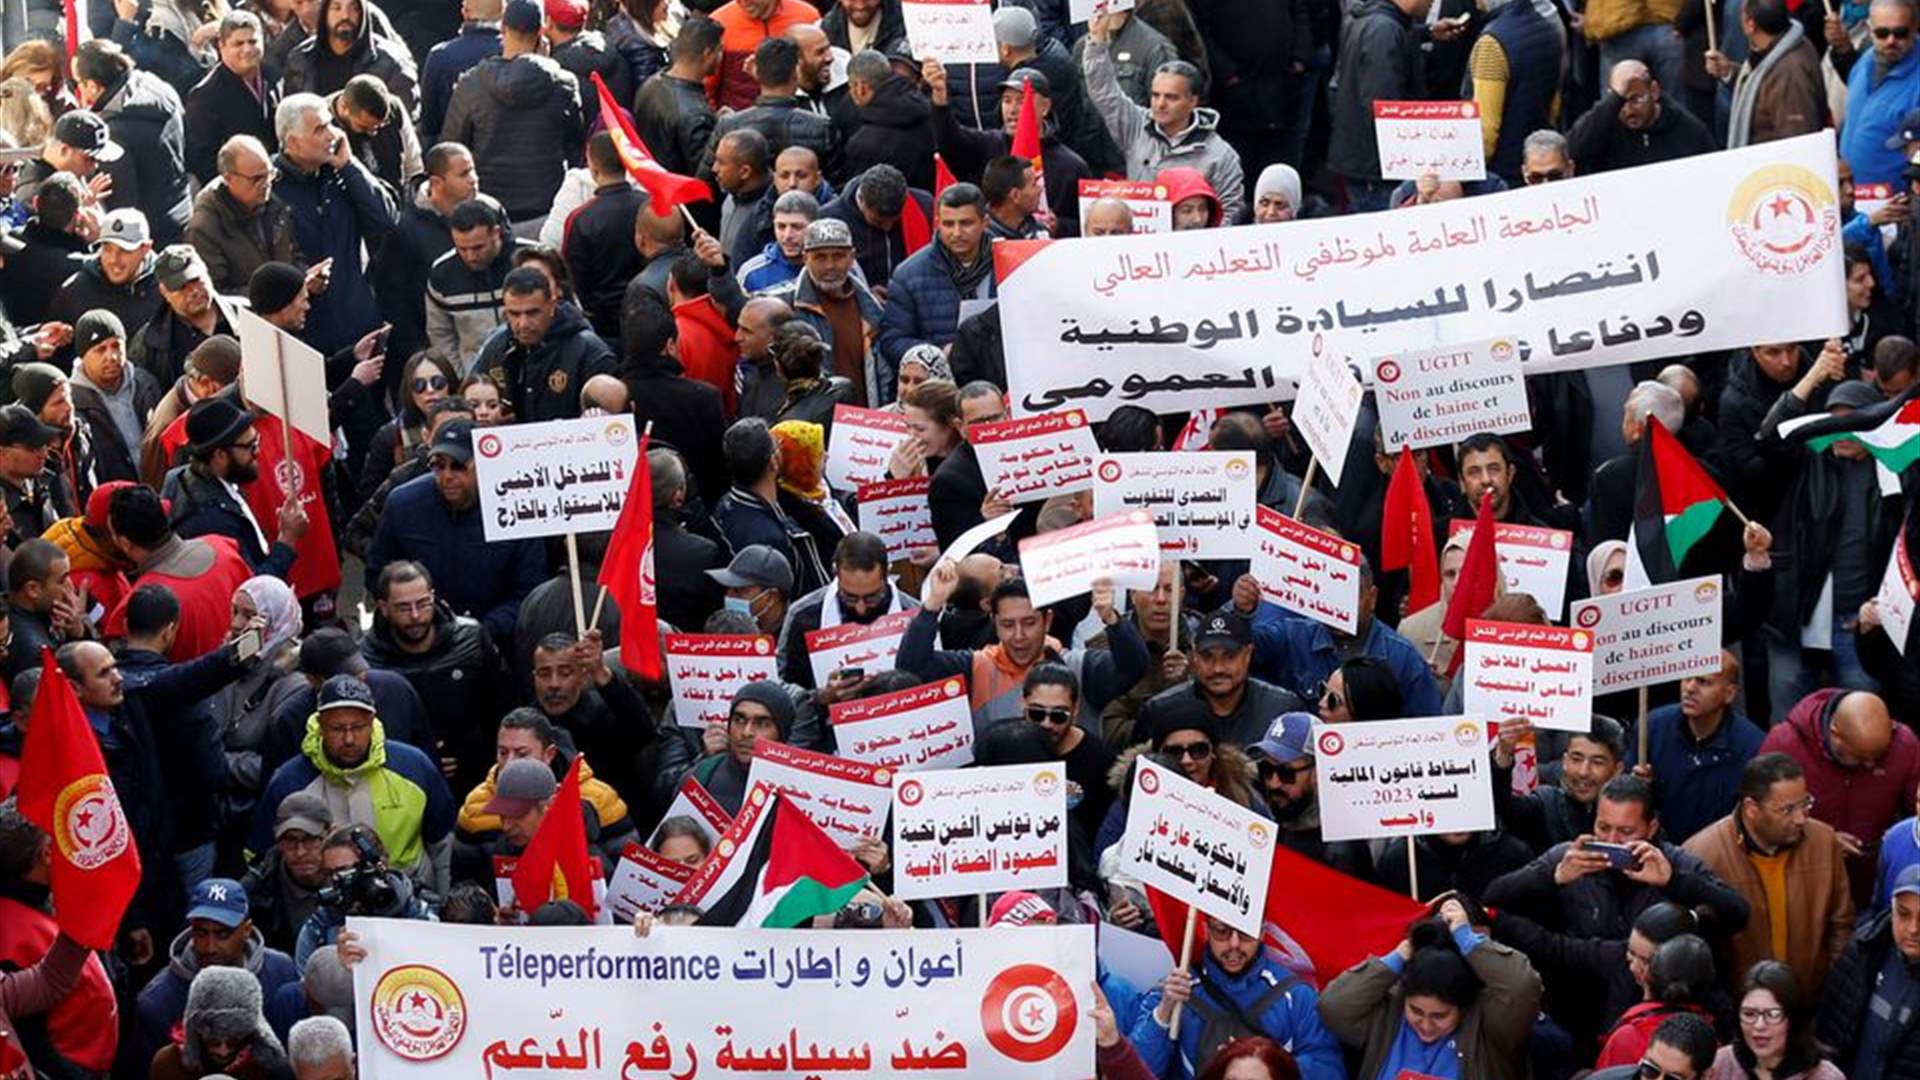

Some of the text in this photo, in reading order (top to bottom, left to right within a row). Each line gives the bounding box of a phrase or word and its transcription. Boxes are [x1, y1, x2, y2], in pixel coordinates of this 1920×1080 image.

[1094, 196, 1600, 297] الجامعة العامة لموظفي التعليم العالي
[1483, 250, 1661, 313] انتصارا
[1060, 308, 1259, 351] الوطنية
[1548, 308, 1706, 358] ودفاعا
[1419, 351, 1472, 373] UGTT
[1386, 373, 1515, 404] Non au discours
[1412, 394, 1499, 420] de haine et
[1413, 410, 1528, 441] discrimination
[554, 461, 610, 490] للتدخل
[613, 459, 624, 479] لا
[1122, 487, 1227, 508] التصدي للتفويت
[497, 498, 547, 528] بالخارج
[1177, 511, 1251, 531] في المؤسسات
[1619, 593, 1676, 616] UGTT
[1596, 614, 1713, 647] on au discours
[1530, 658, 1577, 673] العمل
[1605, 638, 1693, 665] de haine et
[1601, 654, 1720, 686] discrimination
[852, 720, 957, 754] حماية حقوق
[1330, 759, 1476, 787] إسقاط قانون المالية
[818, 794, 872, 815] حماية
[1418, 784, 1458, 800] لسنة
[900, 806, 1060, 848] من تونس ألفين تحية
[1380, 810, 1435, 828] واجب
[952, 848, 997, 873] الضفة
[1002, 845, 1057, 874] لصمود
[1135, 839, 1153, 862] نار
[1156, 851, 1197, 884] شعلت
[479, 938, 963, 988] أعوان و إطارات Téleperformance
[621, 1021, 698, 1080] رفع
[715, 1023, 872, 1080] سياسة
